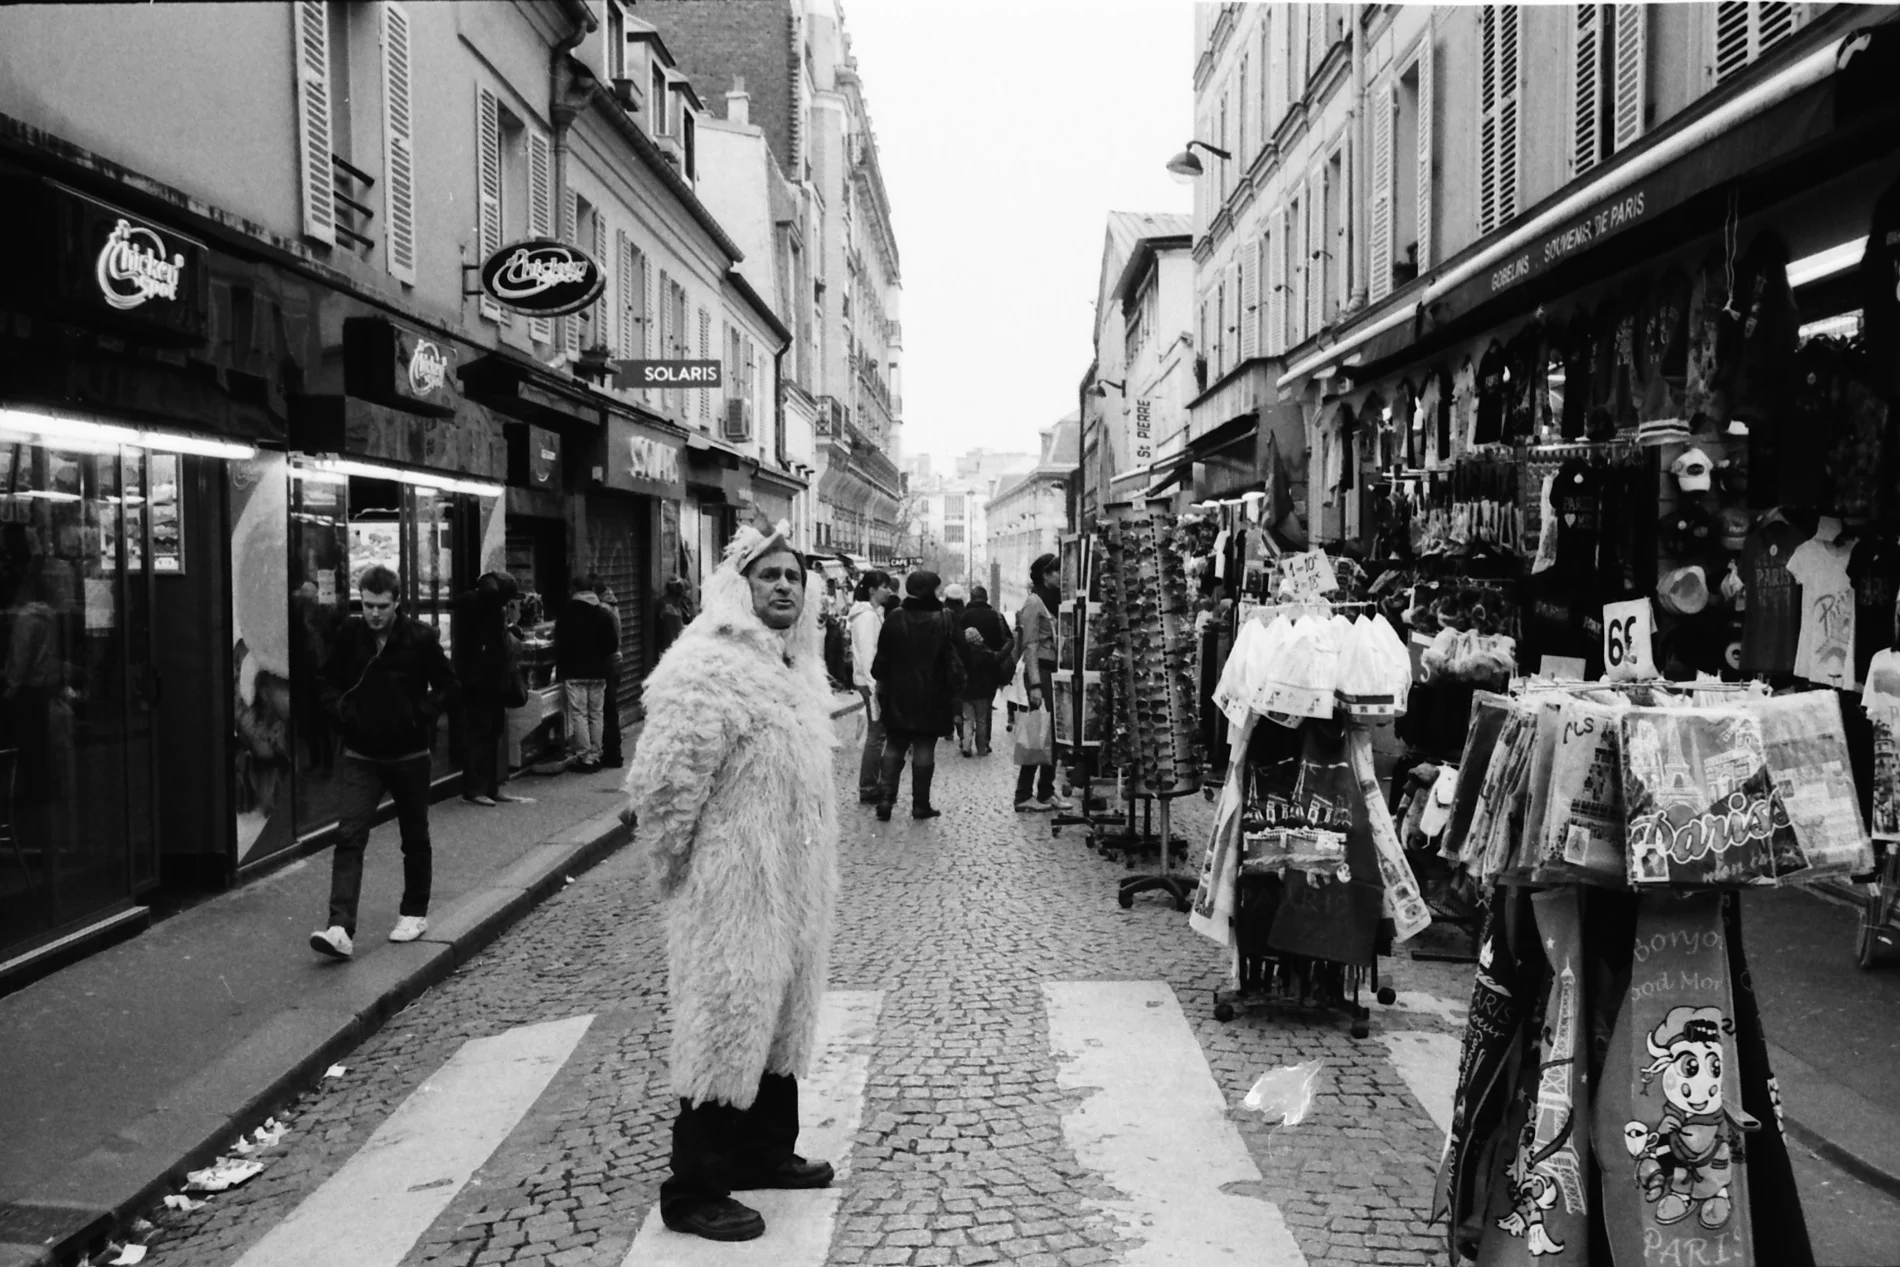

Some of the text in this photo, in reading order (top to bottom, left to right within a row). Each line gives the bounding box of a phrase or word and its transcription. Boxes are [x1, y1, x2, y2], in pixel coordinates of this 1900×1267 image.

[1491, 191, 1645, 292] GOBELINS SOUVENIR DE PARIS
[106, 237, 182, 288] Chicken
[644, 366, 718, 382] SOLARIS
[1136, 399, 1151, 439] PIERRE
[1629, 787, 1793, 865] Paris
[1474, 986, 1513, 1025] ARIS
[1631, 971, 1676, 1001] ood
